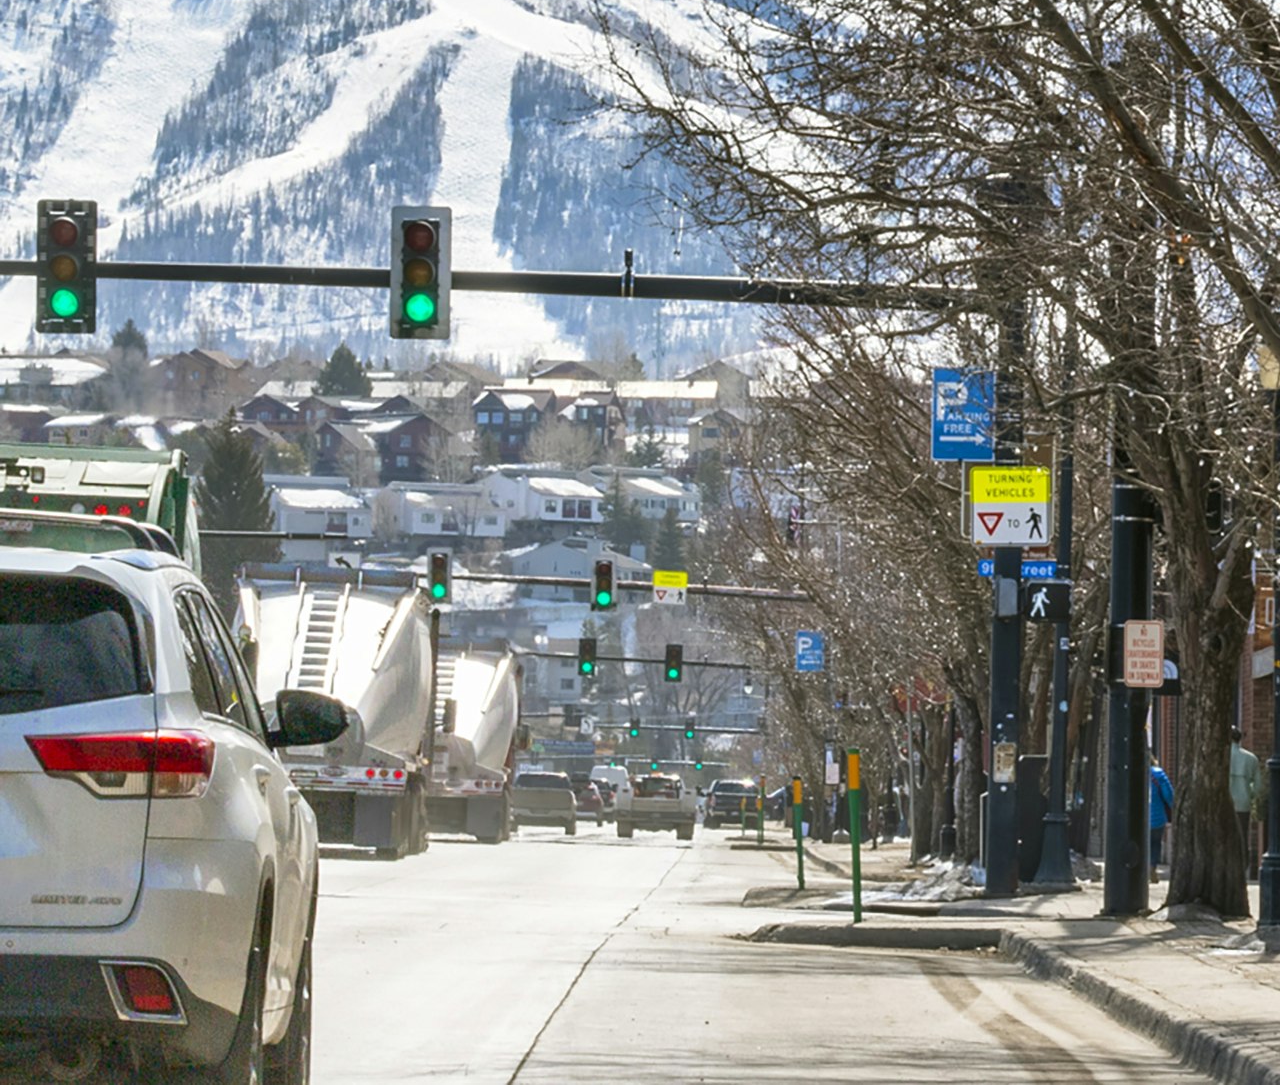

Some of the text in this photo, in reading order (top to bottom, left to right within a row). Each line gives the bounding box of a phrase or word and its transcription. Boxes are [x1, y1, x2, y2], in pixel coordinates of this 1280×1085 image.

[944, 423, 972, 433] FREE
[988, 474, 1033, 484] TURNING
[985, 488, 1036, 498] VEHICLES
[1008, 519, 1020, 528] TO
[1021, 565, 1053, 576] reet
